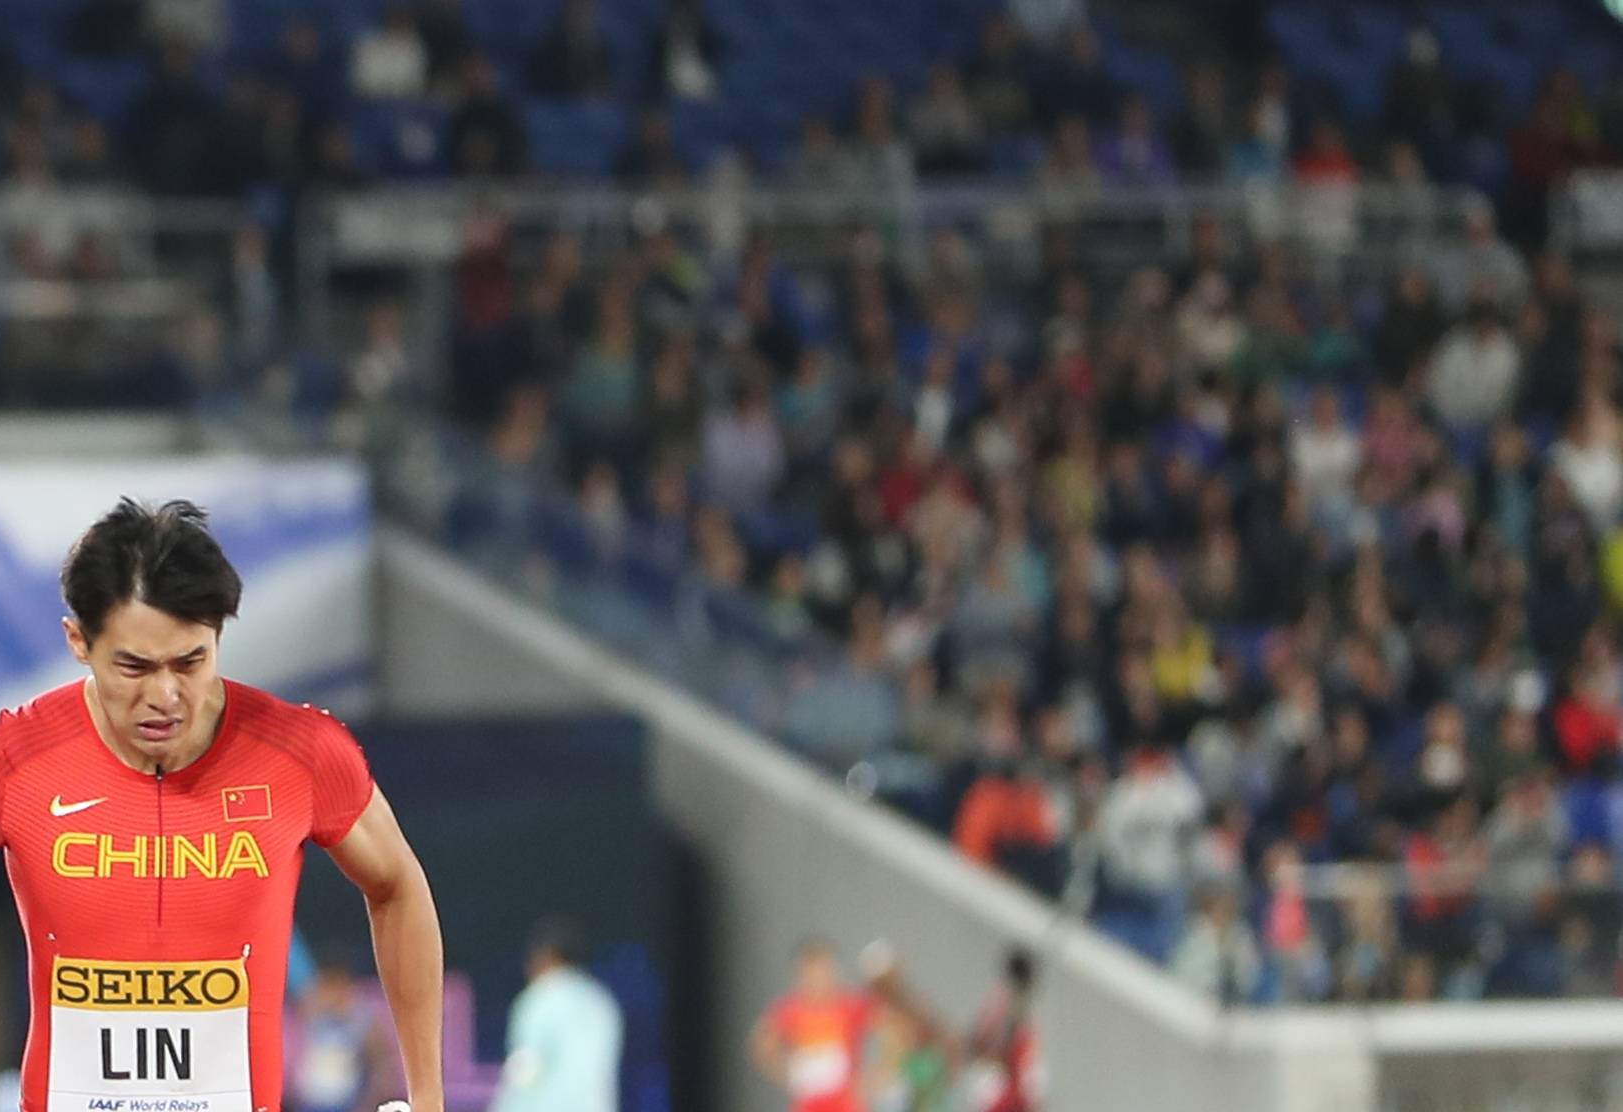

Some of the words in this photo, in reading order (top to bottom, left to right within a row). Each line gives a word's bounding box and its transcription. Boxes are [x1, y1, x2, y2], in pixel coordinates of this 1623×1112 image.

[50, 830, 270, 880] CHINA
[55, 965, 241, 1006] SEIKO
[99, 1027, 192, 1081] LIN
[88, 1098, 126, 1111] IAAF
[130, 1100, 166, 1112] World
[169, 1099, 209, 1112] Relays
